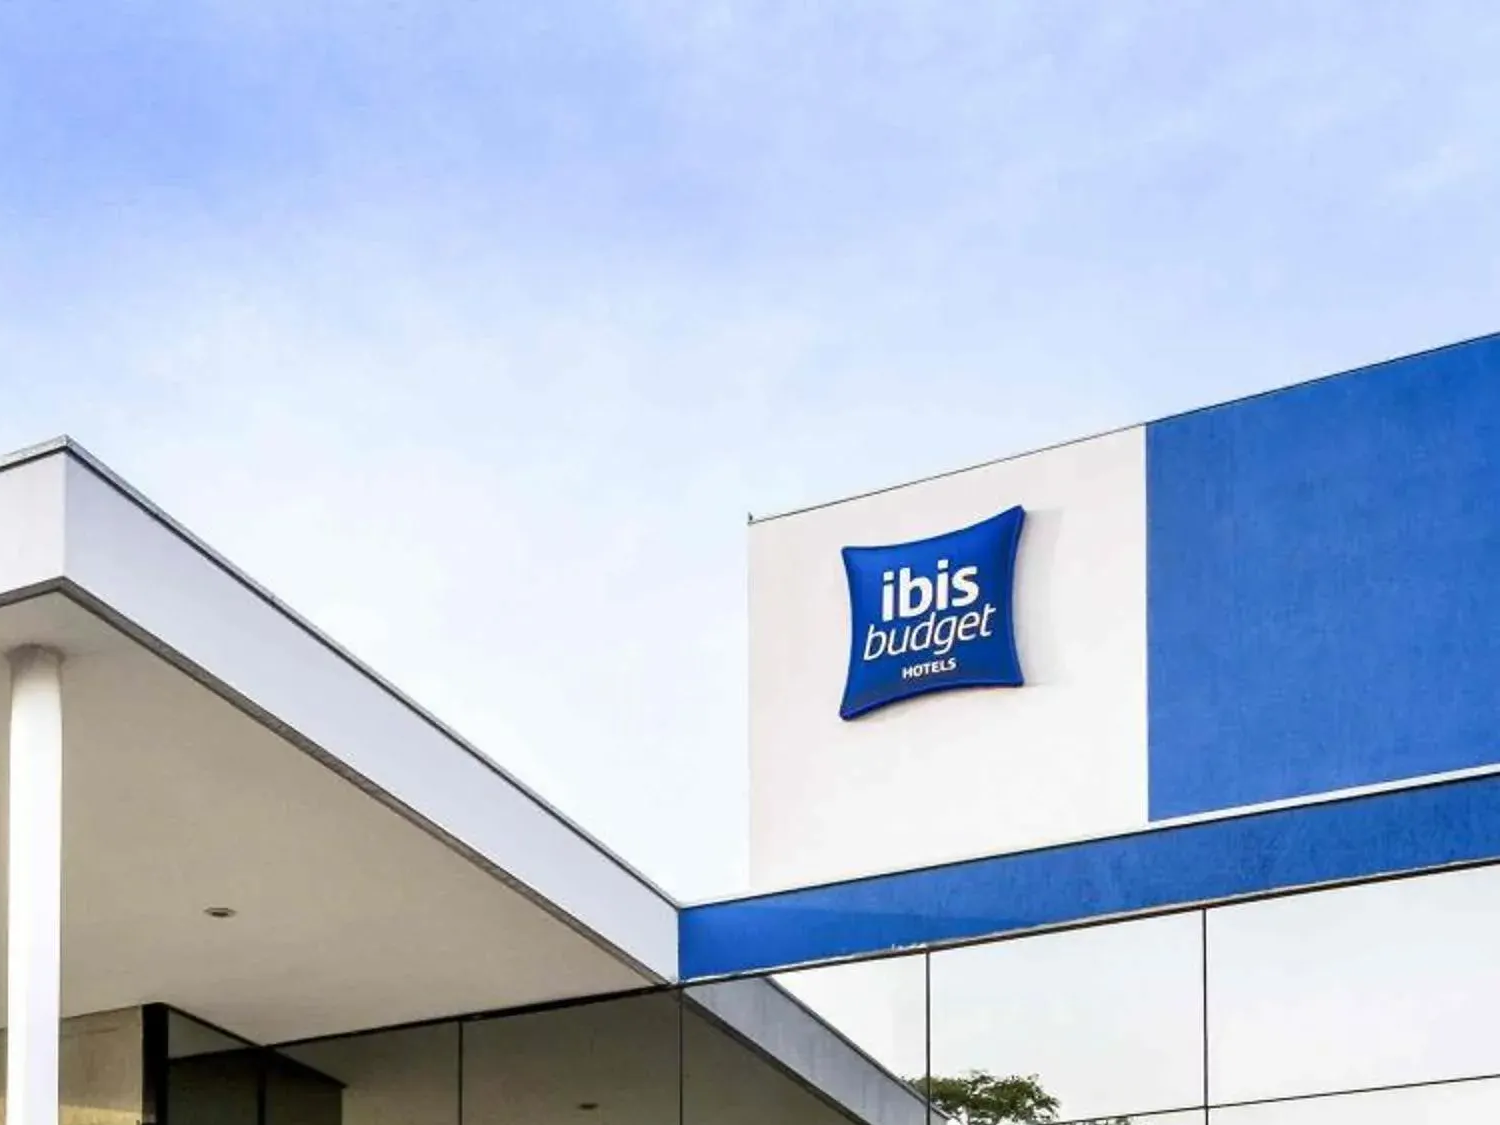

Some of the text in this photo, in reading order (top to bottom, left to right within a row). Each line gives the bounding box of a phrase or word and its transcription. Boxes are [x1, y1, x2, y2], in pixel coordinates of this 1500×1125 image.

[882, 559, 980, 622] ibis
[863, 603, 996, 661] budget
[902, 657, 957, 680] HOTELS
